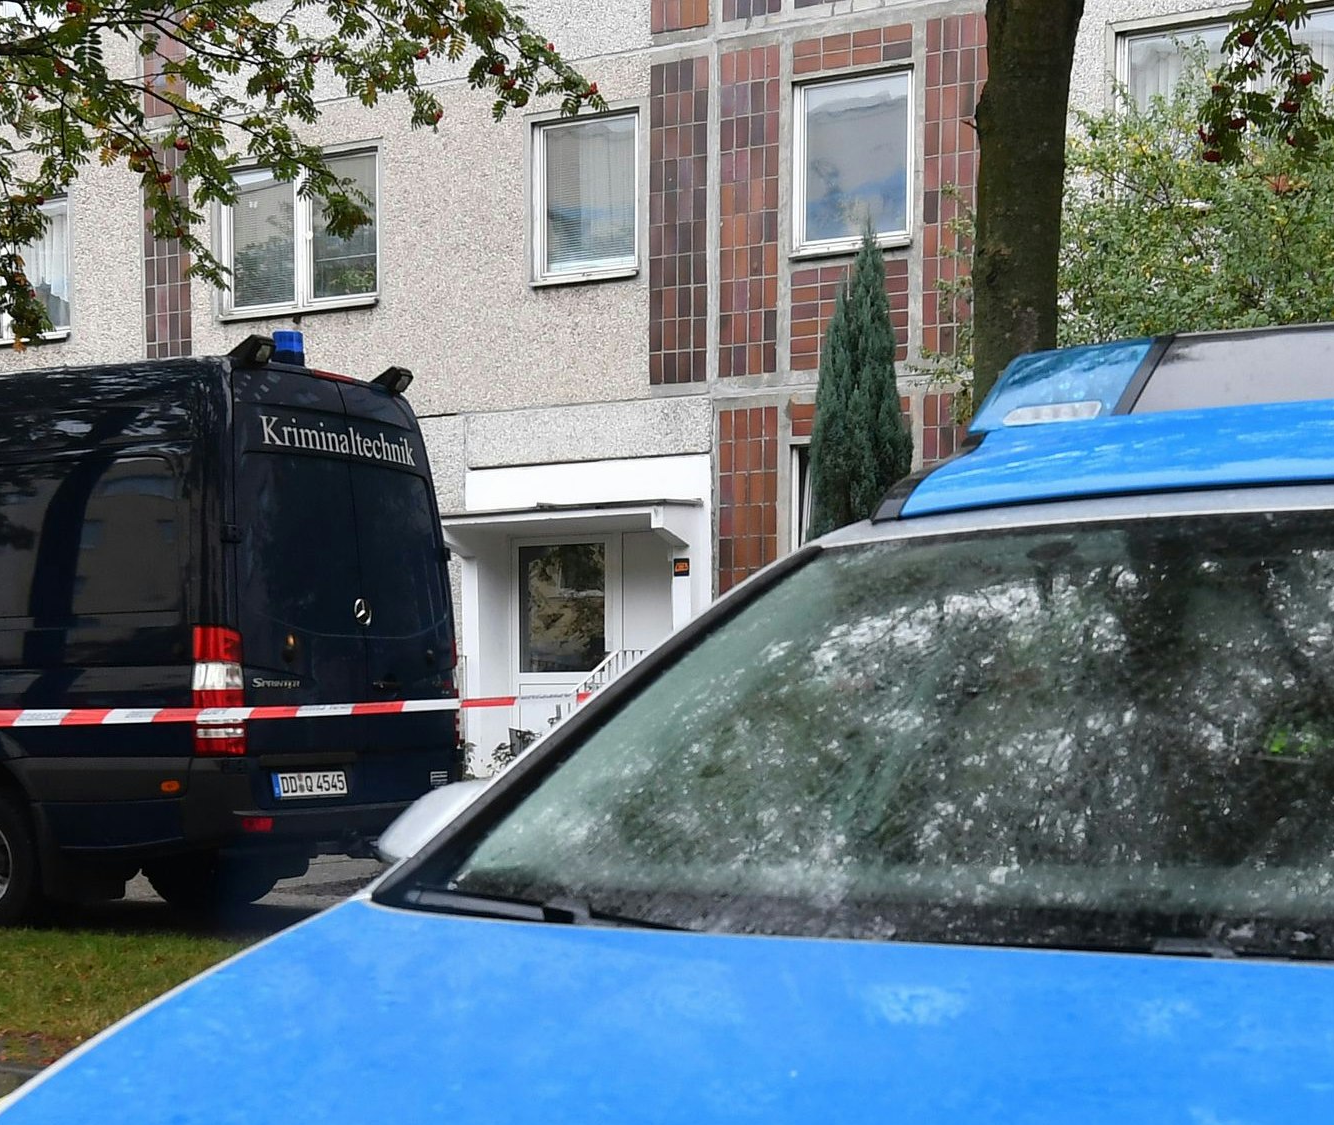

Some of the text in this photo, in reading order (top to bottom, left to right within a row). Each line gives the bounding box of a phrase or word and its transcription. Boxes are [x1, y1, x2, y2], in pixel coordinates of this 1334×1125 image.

[259, 415, 416, 467] Kriminaltechnik
[280, 776, 298, 794] DD
[316, 773, 345, 792] 4545
